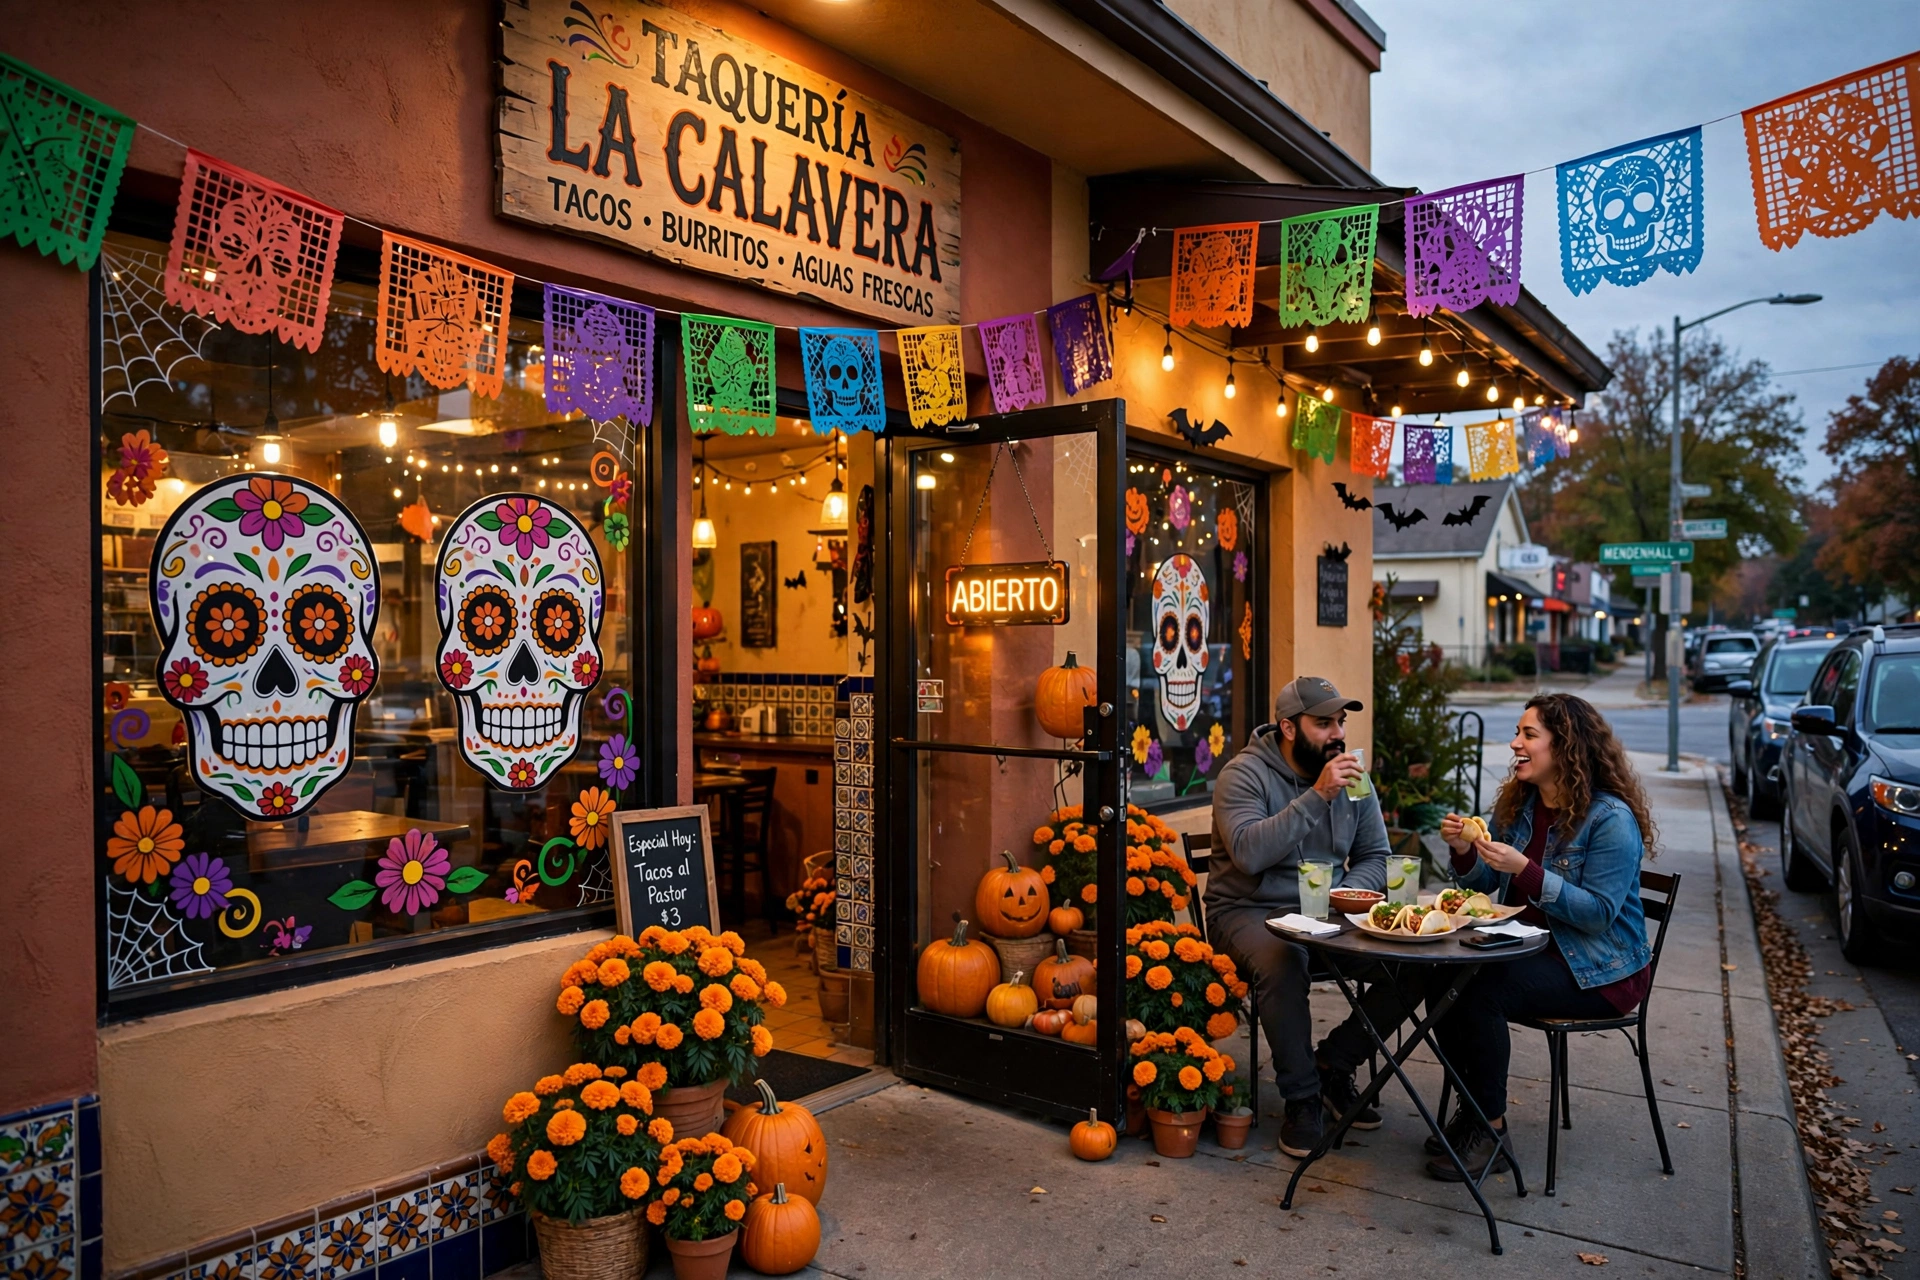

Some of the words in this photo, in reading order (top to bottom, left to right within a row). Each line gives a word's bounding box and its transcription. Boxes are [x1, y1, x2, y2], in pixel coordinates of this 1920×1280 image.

[642, 19, 875, 167] TAQUERÍA
[546, 58, 643, 188] LA
[663, 108, 943, 283] CALAVERA
[547, 176, 632, 231] TACOS
[662, 211, 769, 270] BURRITOS
[792, 251, 854, 295] AGUAS
[862, 273, 934, 318] FRESCAS
[1604, 546, 1674, 560] MENDENHALL
[951, 577, 1058, 613] ABIERTO
[628, 830, 669, 857] Especial
[671, 829, 697, 852] Hoy:
[634, 862, 673, 882] Tacos
[678, 857, 690, 876] al
[647, 885, 687, 905] Pastor
[660, 907, 682, 926] $3
